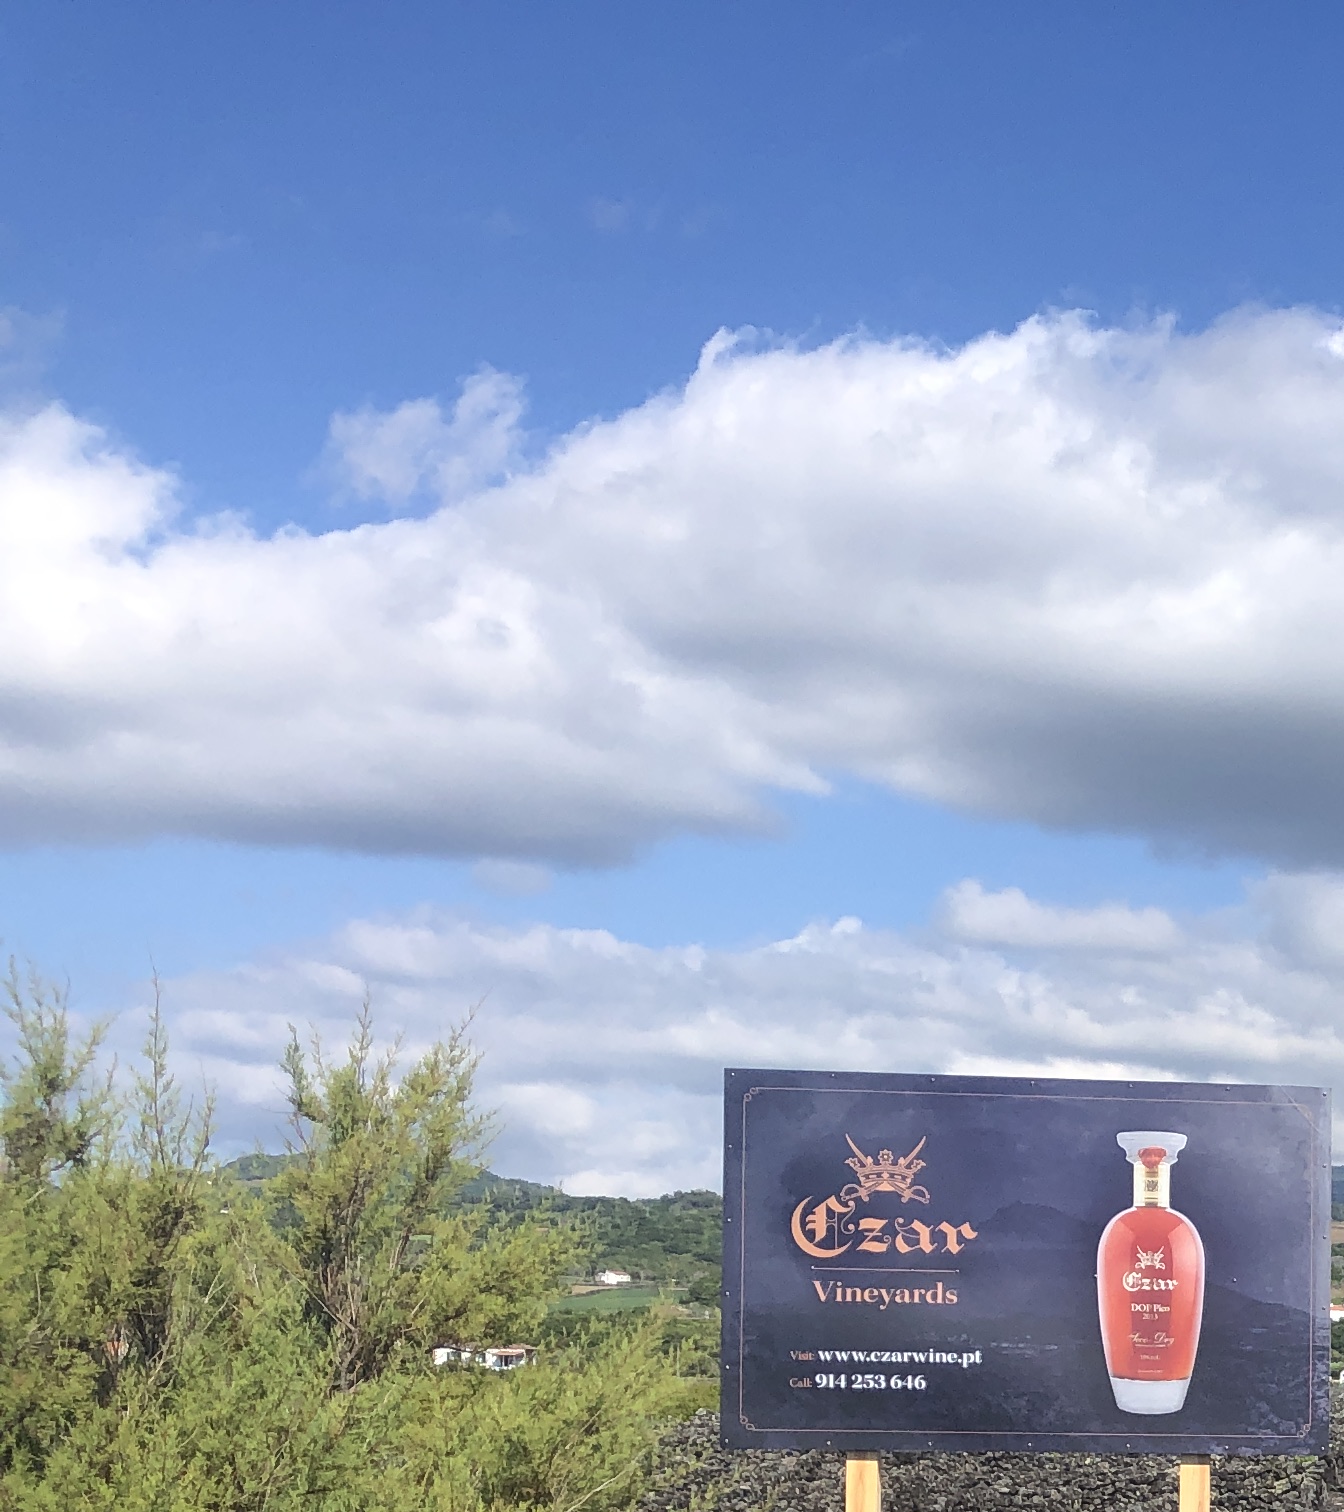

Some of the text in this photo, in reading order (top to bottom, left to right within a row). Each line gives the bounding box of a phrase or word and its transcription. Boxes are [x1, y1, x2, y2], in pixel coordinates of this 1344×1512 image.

[791, 1195, 978, 1258] Czar
[1122, 1271, 1179, 1292] Czar
[812, 1280, 958, 1310] Vineyards
[817, 1348, 982, 1368] www.czarwine.pt
[815, 1373, 847, 1389] 914
[851, 1373, 886, 1390] 253
[890, 1374, 927, 1391] 646
